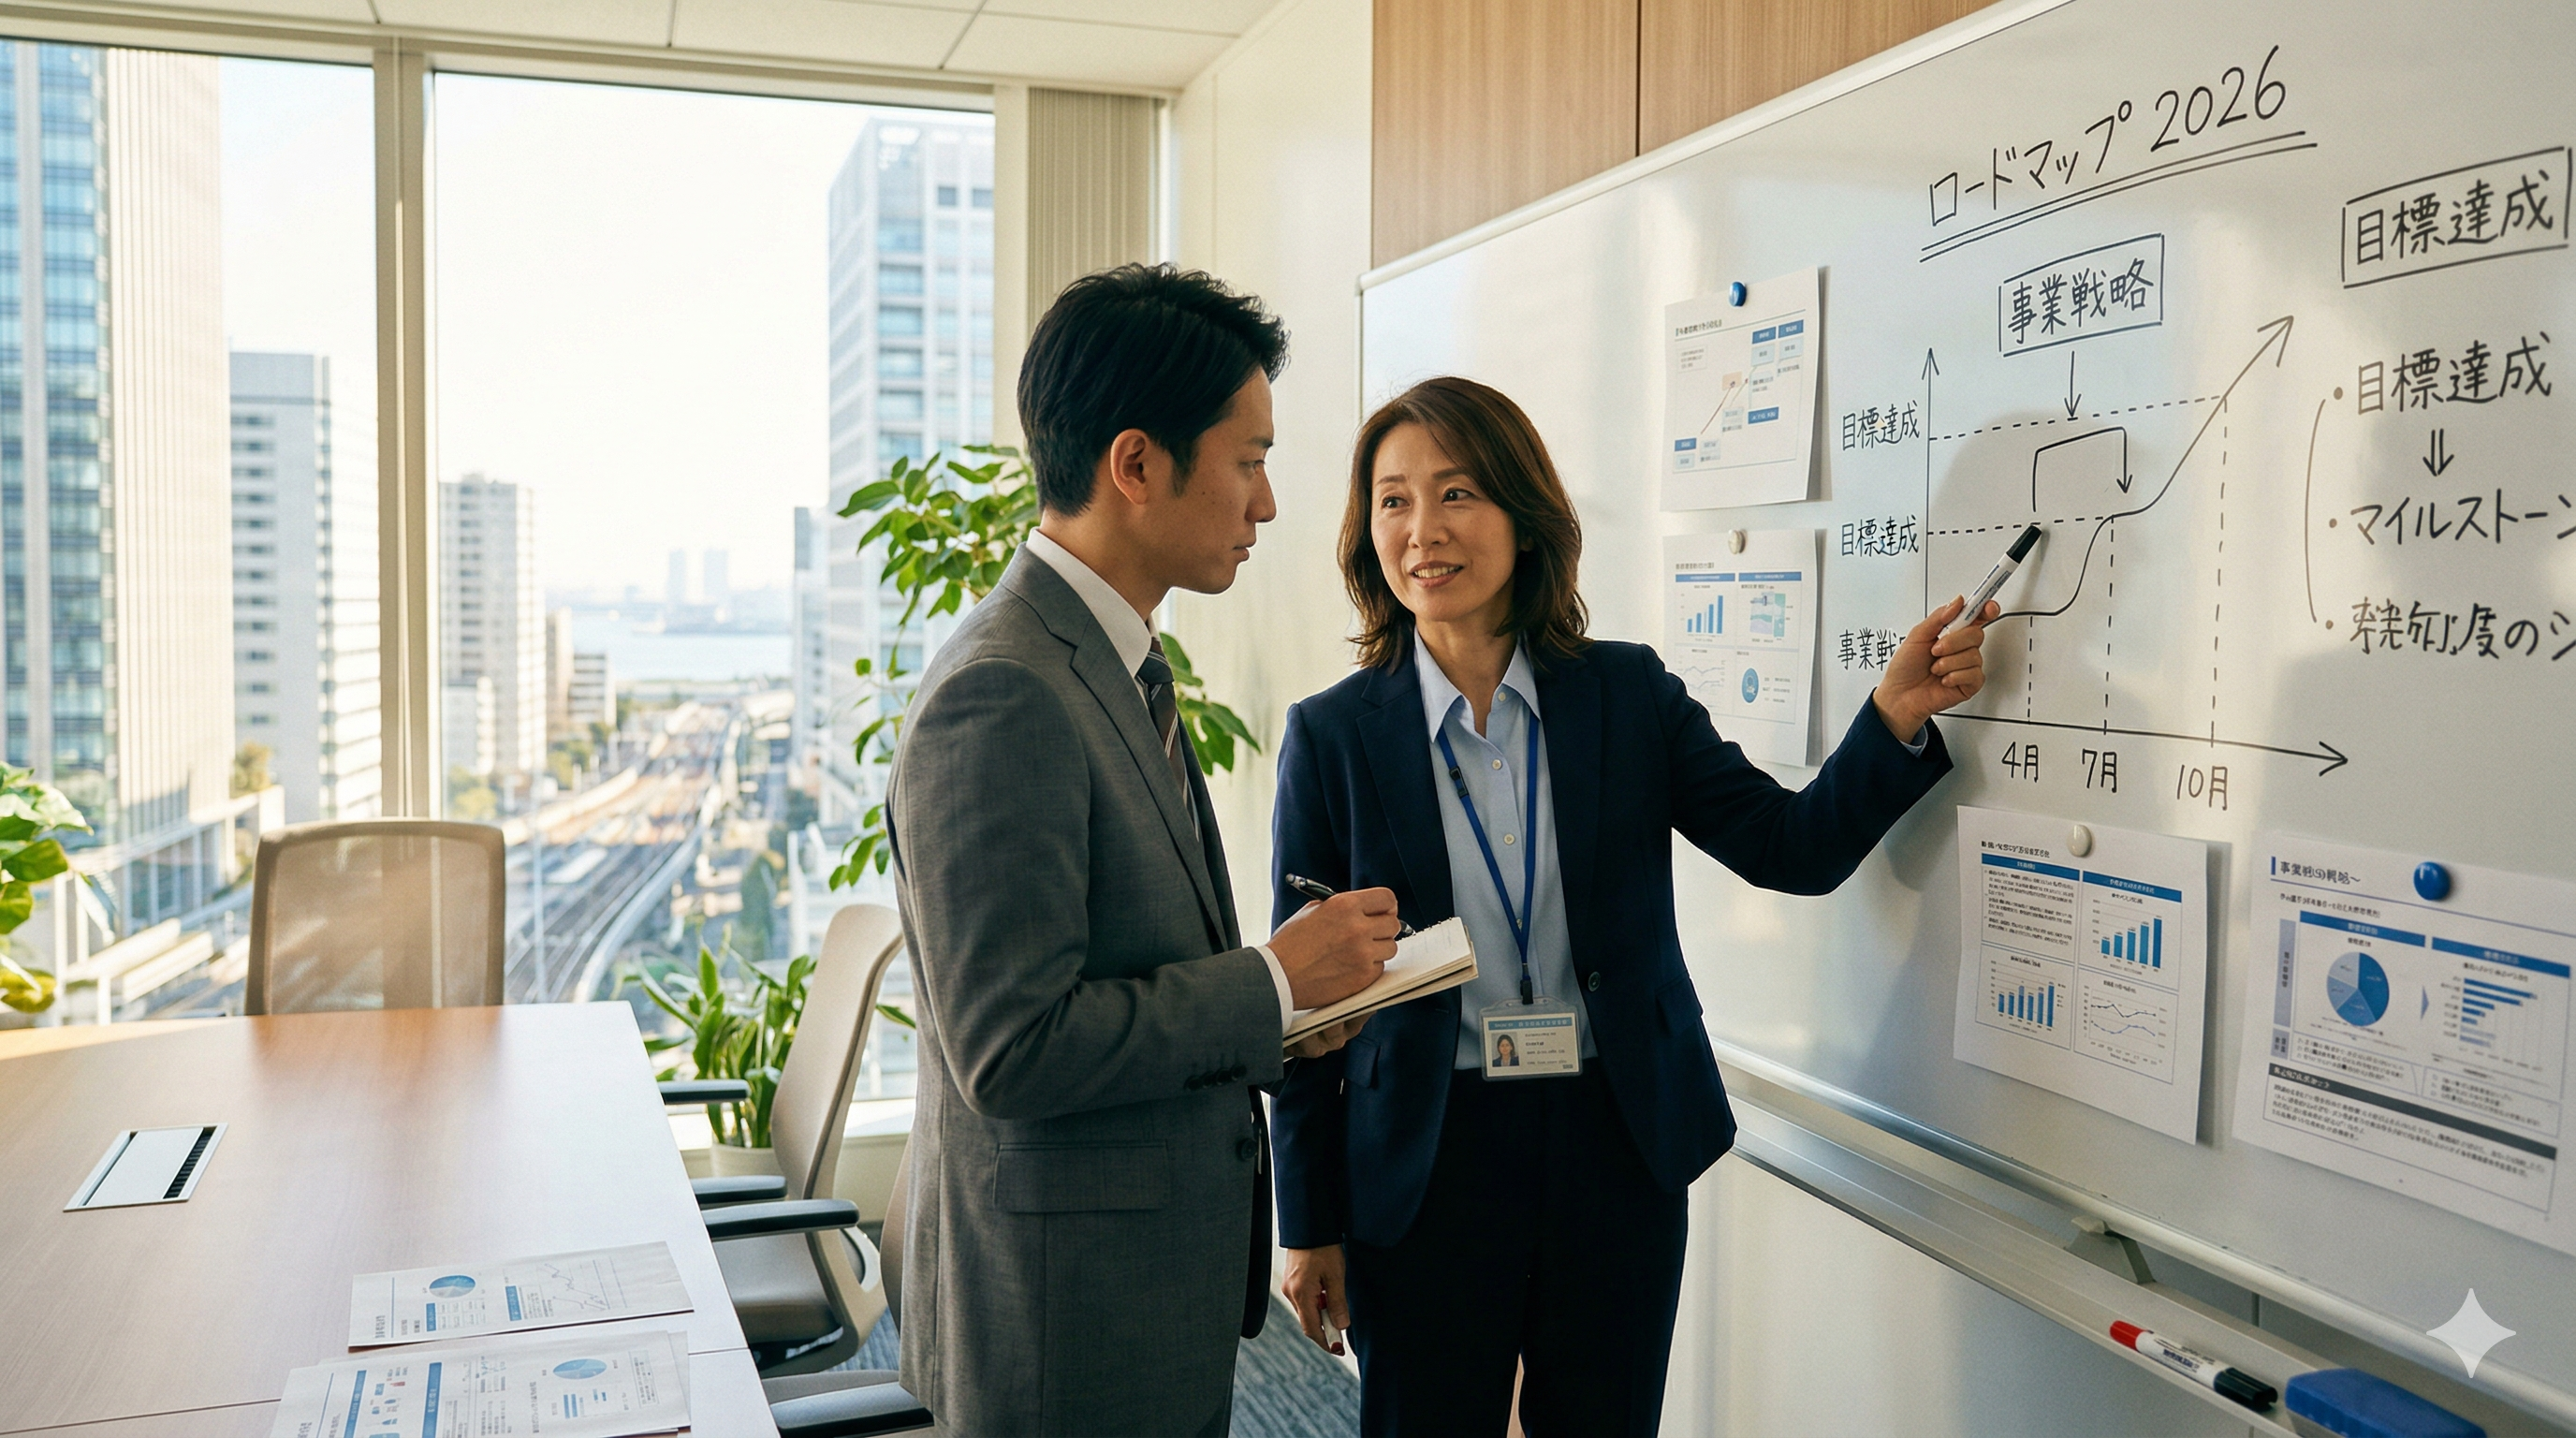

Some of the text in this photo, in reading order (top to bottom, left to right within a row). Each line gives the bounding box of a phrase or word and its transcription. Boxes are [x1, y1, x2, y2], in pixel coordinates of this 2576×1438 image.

[1930, 45, 2286, 226] ロードマップ 2026
[2356, 169, 2554, 265] 目標達成
[2007, 257, 2155, 345] 事業戦略
[2358, 331, 2552, 416] 目標達成
[1842, 400, 1920, 451] 目標達成
[1841, 514, 1920, 558] 目標達成
[2349, 488, 2576, 546] マイルストーン
[1837, 626, 1907, 671] 事業戦
[2001, 741, 2229, 812] 4月 7月 10月
